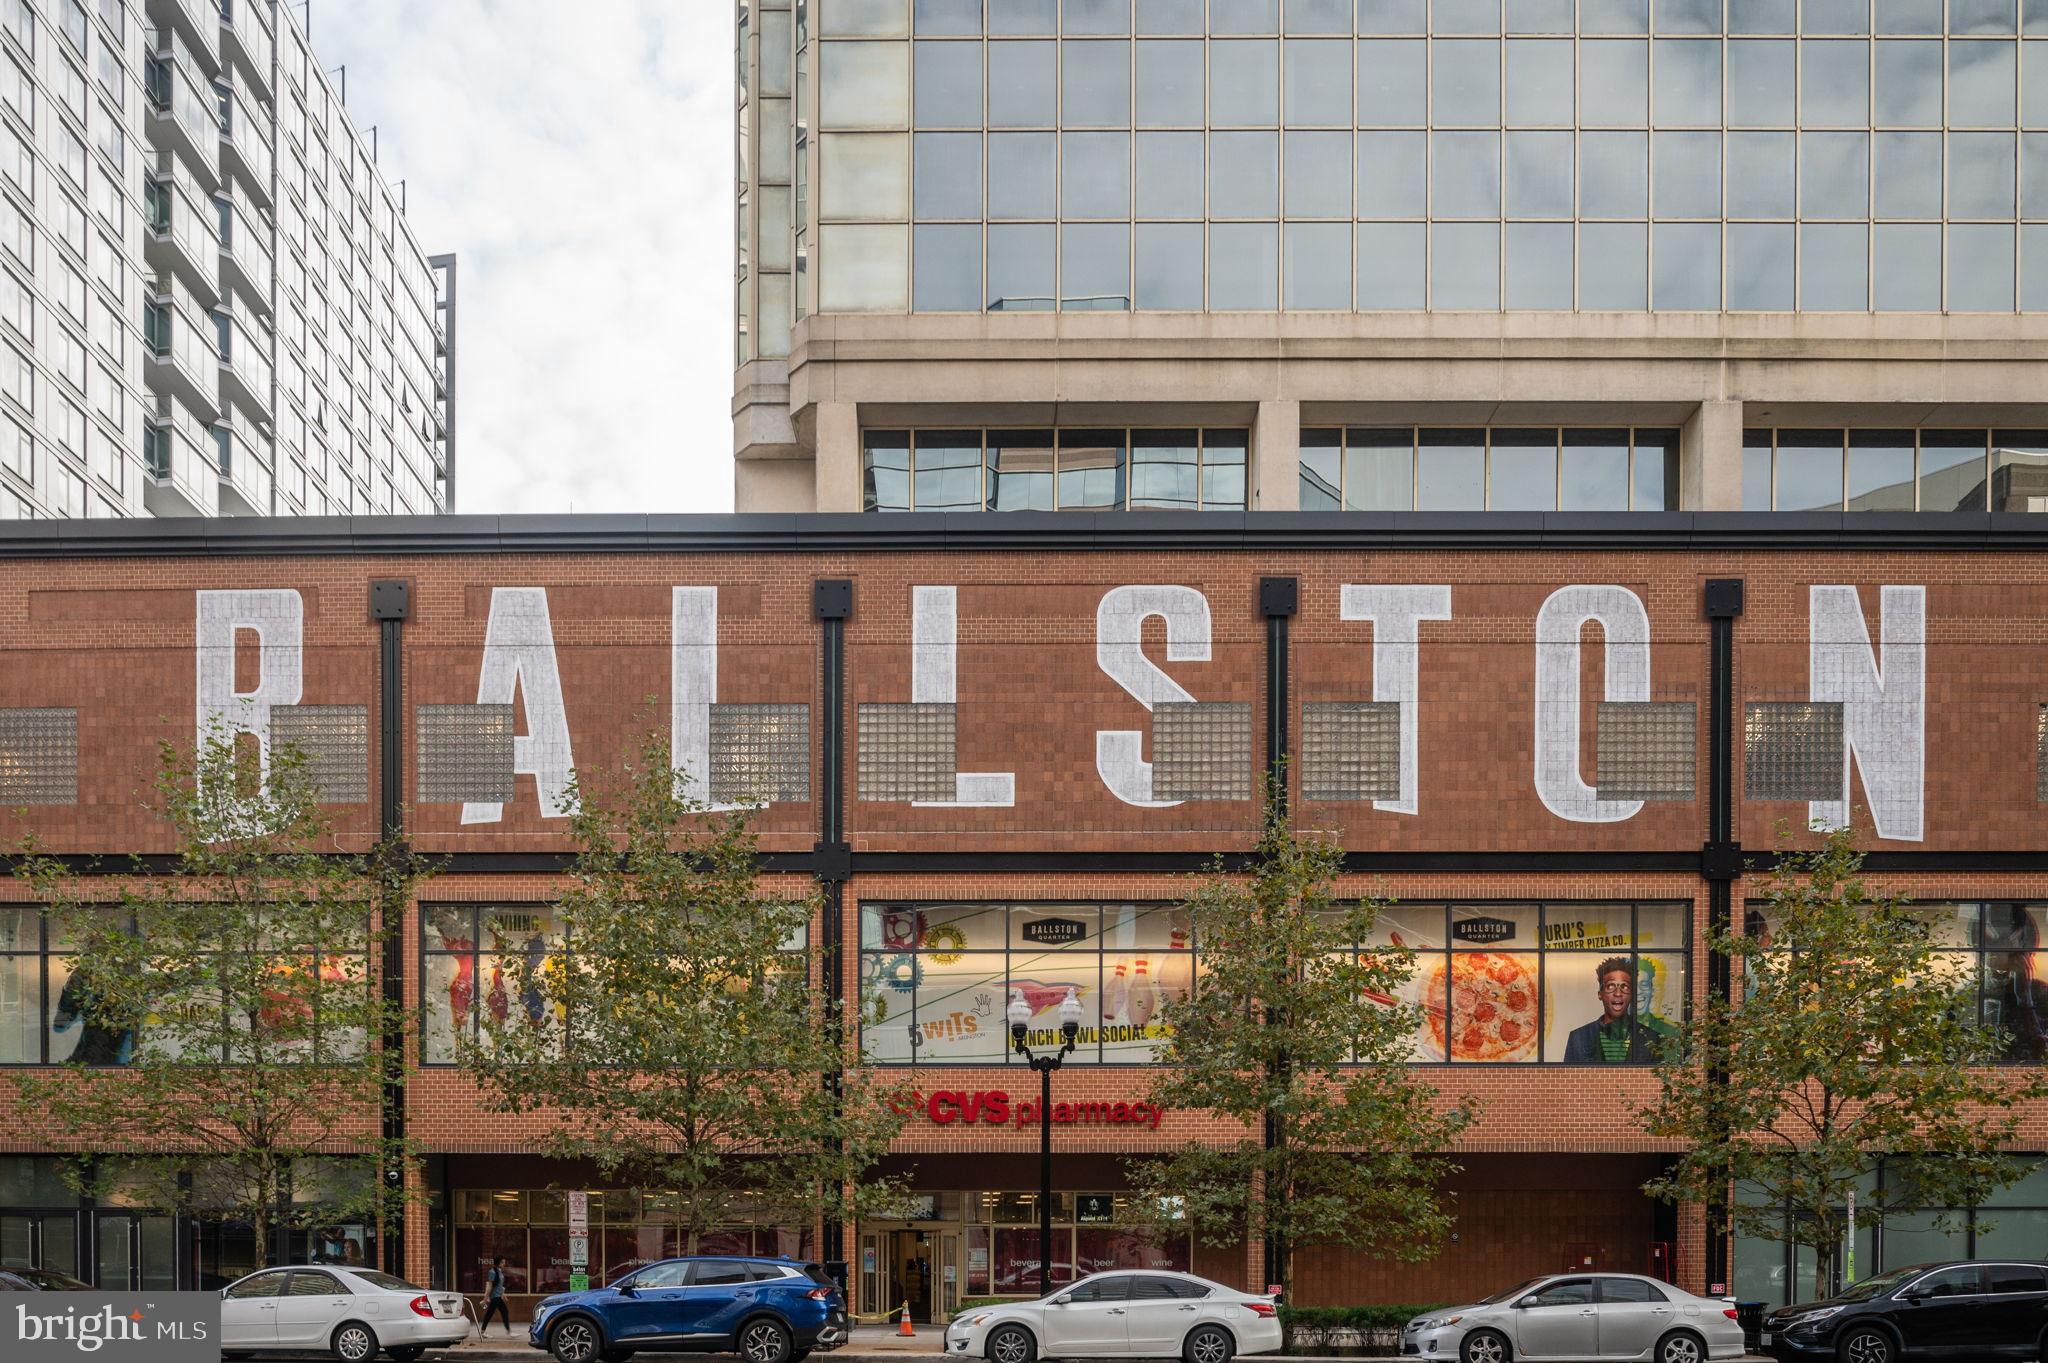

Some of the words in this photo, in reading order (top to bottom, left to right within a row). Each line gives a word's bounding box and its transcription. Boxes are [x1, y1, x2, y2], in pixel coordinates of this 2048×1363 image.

[195, 584, 1927, 844] BALLSTON
[1031, 924, 1078, 935] BALLSTON
[1461, 924, 1507, 934] BALLSTON
[1537, 921, 1585, 941] URU'S
[1553, 939, 1585, 949] TIMBER
[1587, 936, 1611, 948] PIZZA
[1612, 934, 1627, 946] CO.
[1011, 1028, 1054, 1047] NCH
[1059, 1026, 1098, 1045] BWL
[1102, 1023, 1147, 1043] SOCIAL
[927, 1090, 1010, 1124] CVS
[1015, 1095, 1164, 1130] pharmacy
[1093, 1258, 1115, 1267] beer
[1151, 1258, 1173, 1267] wine
